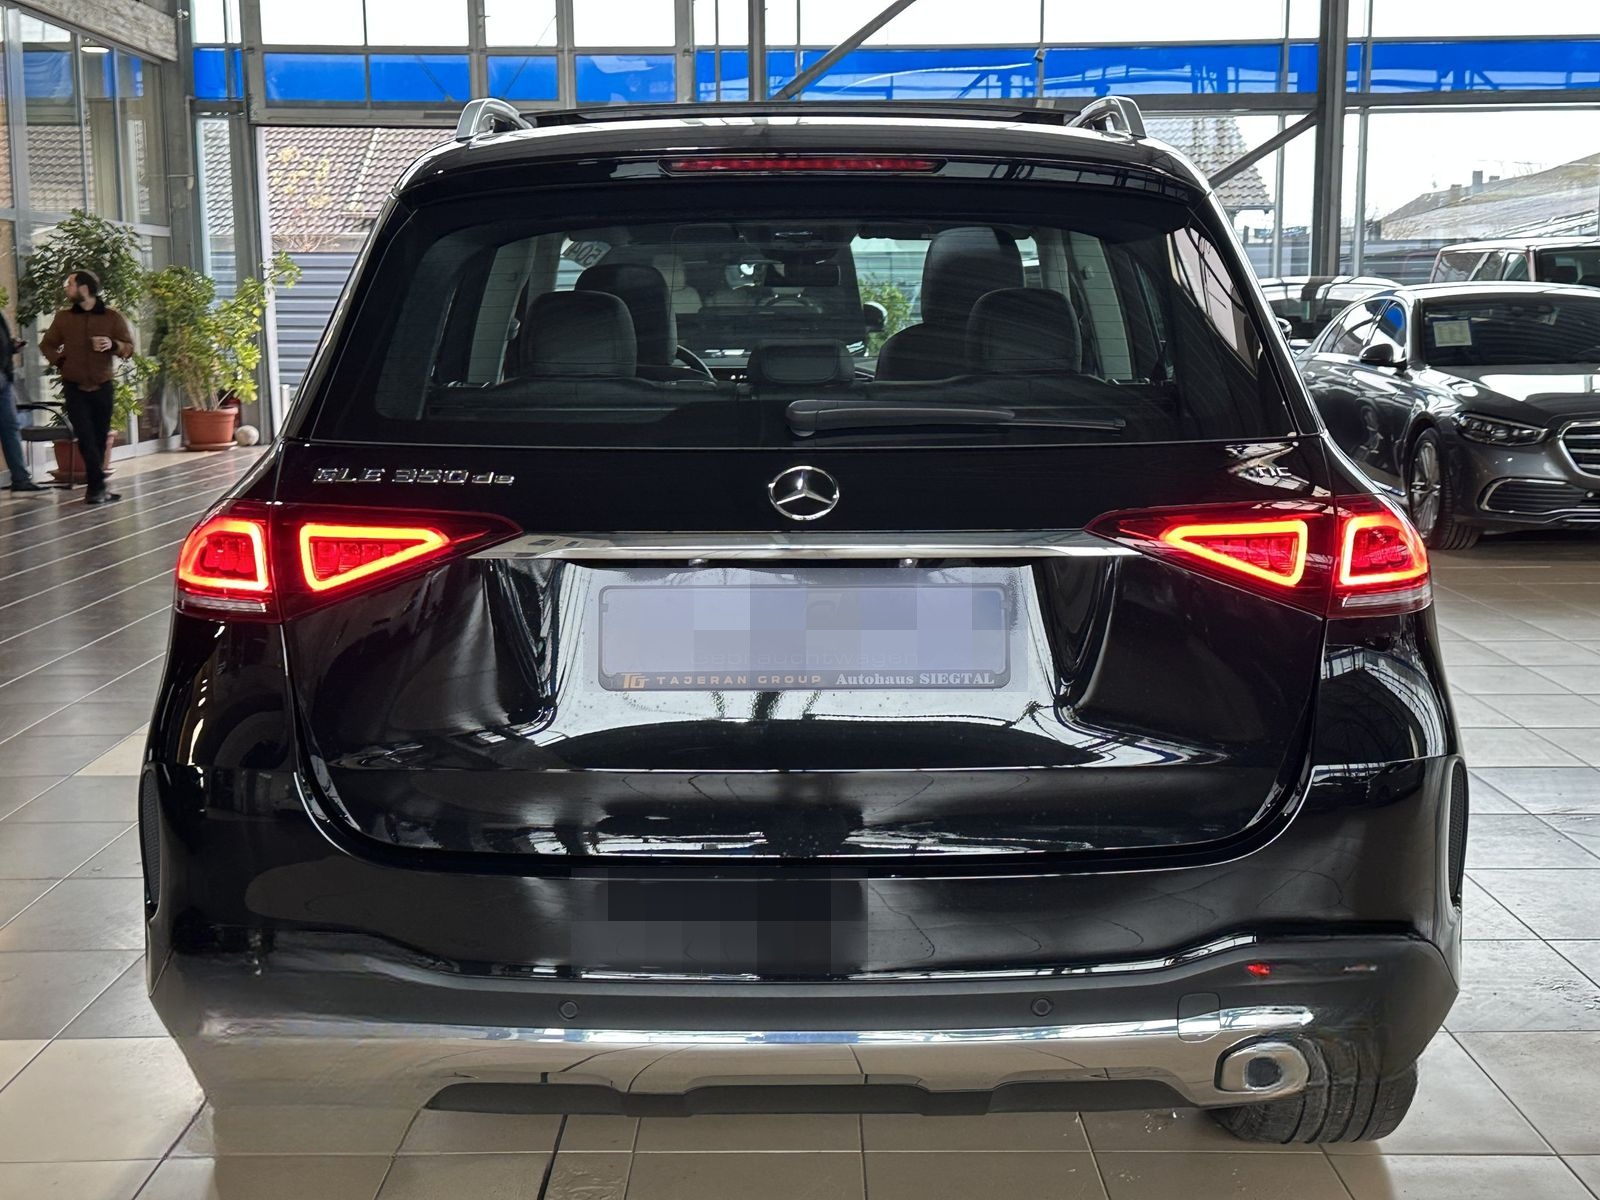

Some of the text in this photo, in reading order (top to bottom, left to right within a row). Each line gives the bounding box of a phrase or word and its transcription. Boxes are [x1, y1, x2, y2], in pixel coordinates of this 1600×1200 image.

[313, 468, 514, 485] GLE 350 de
[621, 673, 822, 689] TG TAJERAN GROUP
[836, 673, 995, 685] Autohaus SIEGTAL
